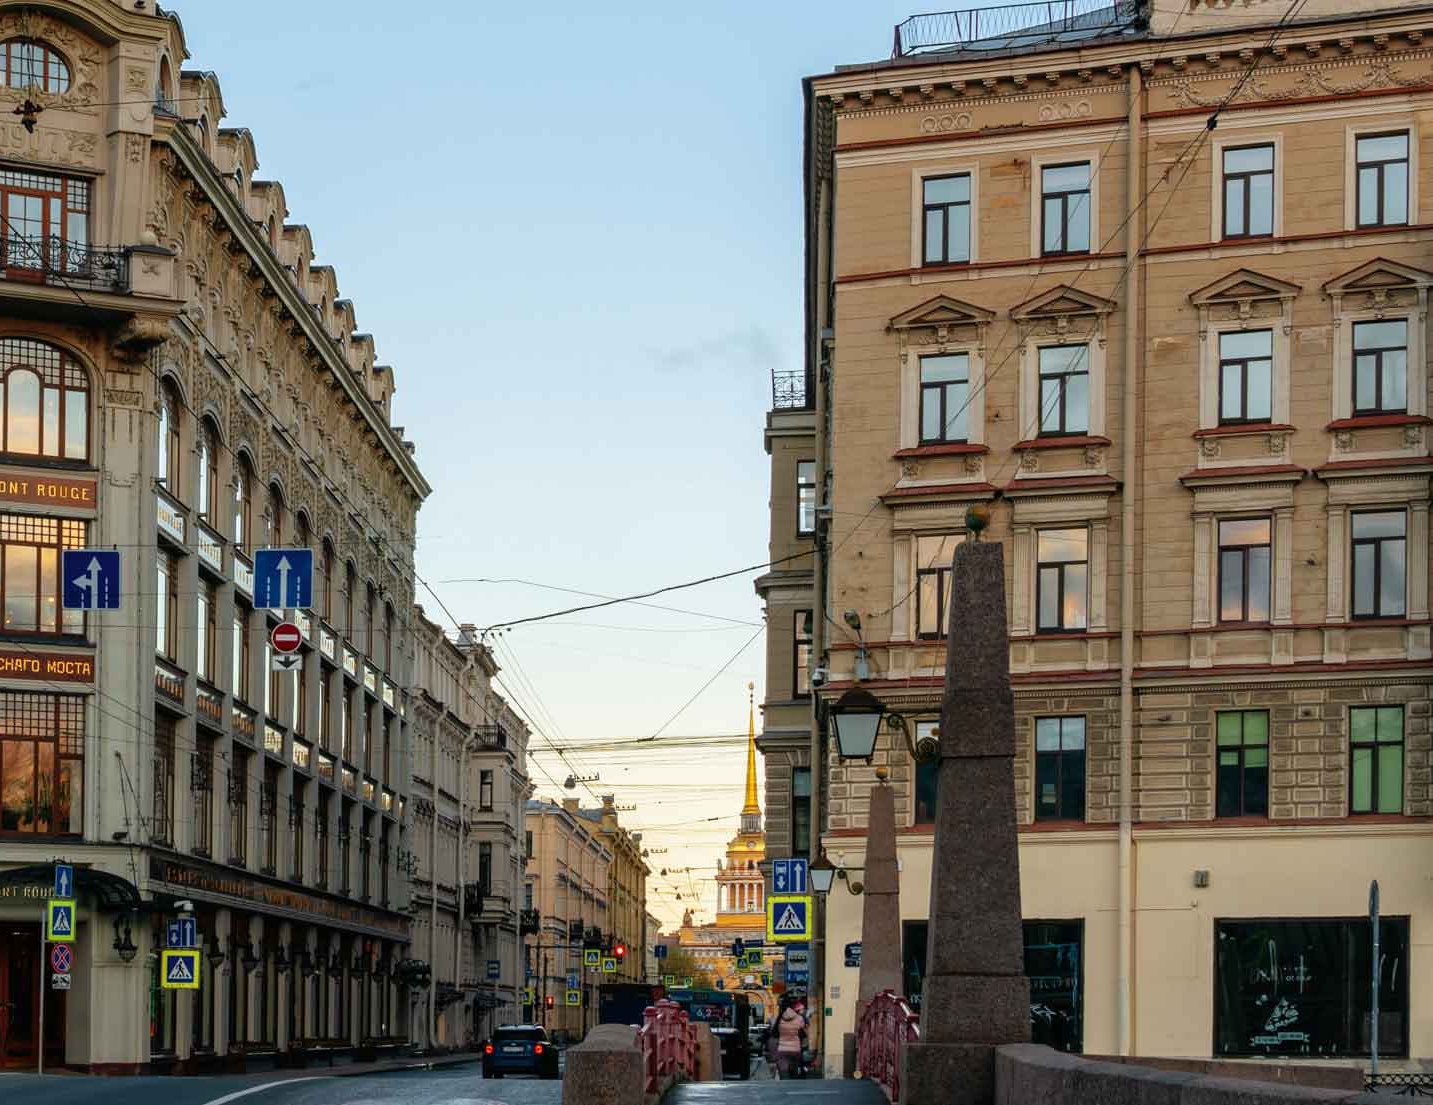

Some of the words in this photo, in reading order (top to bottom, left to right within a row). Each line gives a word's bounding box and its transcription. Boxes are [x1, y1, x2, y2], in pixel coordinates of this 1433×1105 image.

[37, 483, 91, 501] ROUGE
[47, 660, 91, 677] МОСТА
[24, 886, 55, 897] ROUG
